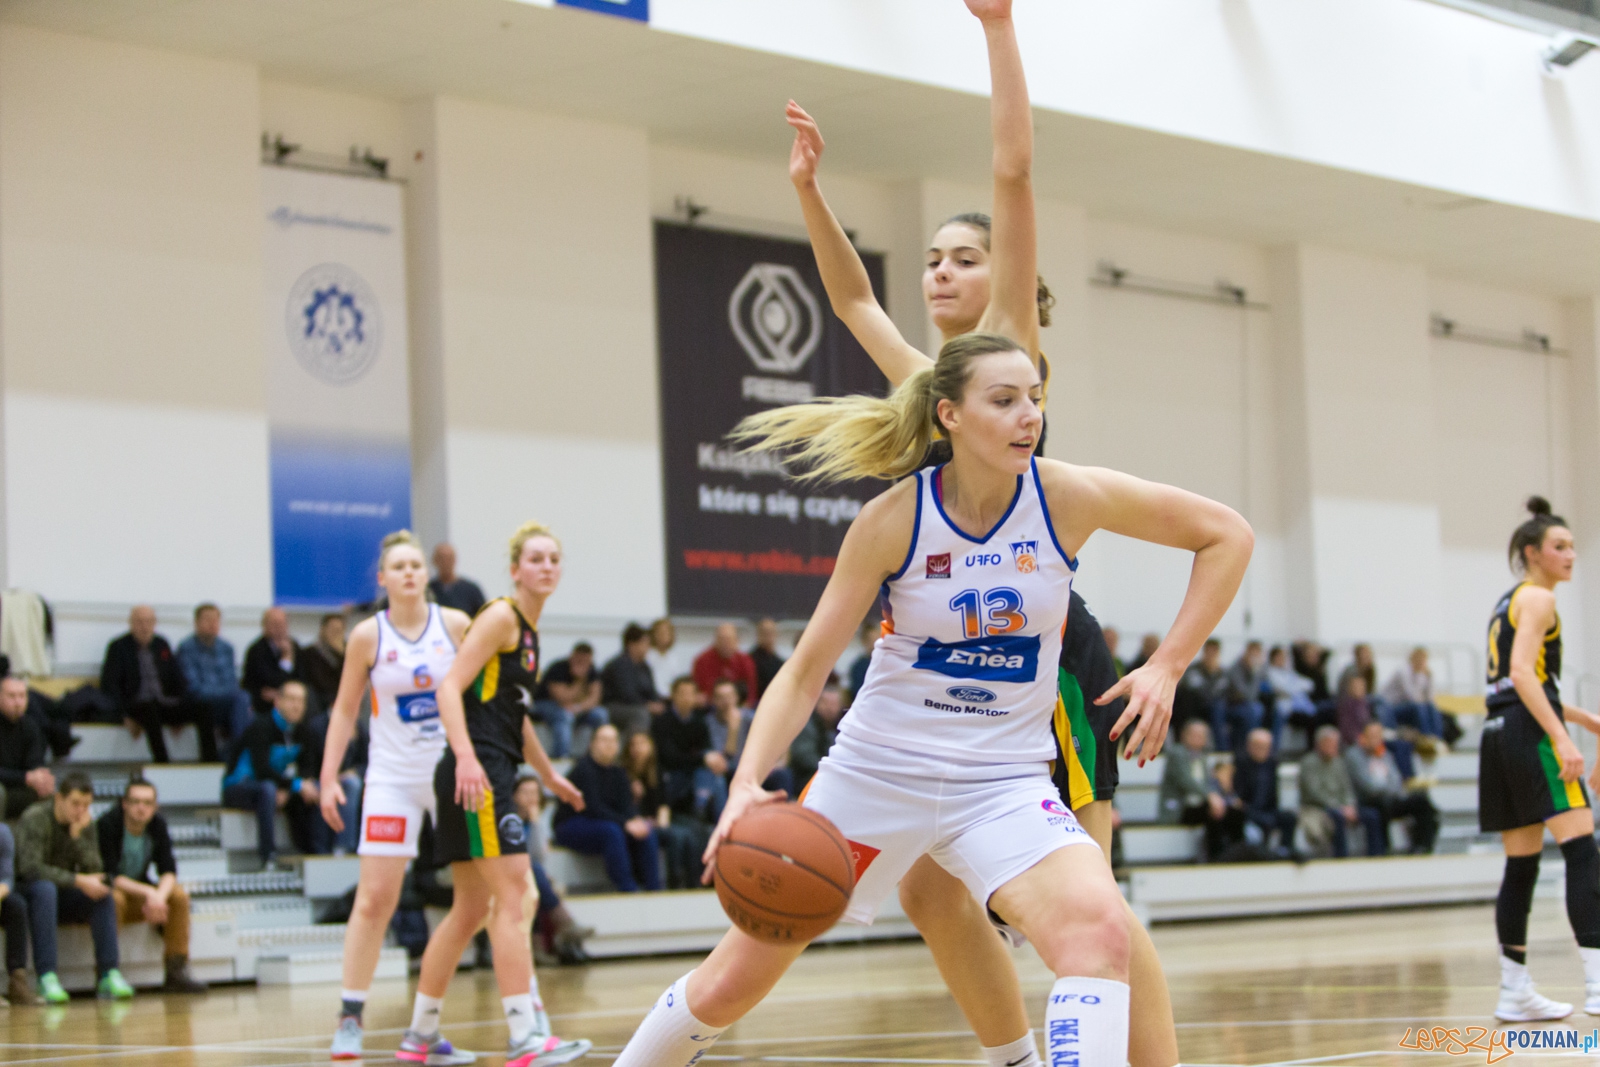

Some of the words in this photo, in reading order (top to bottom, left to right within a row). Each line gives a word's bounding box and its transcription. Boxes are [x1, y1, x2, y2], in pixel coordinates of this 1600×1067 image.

[698, 484, 762, 516] które
[765, 488, 800, 525] się
[949, 586, 1028, 640] 13
[945, 647, 1025, 669] Enea
[413, 664, 433, 688] 6
[924, 698, 962, 714] Bemo
[956, 687, 989, 702] Ford
